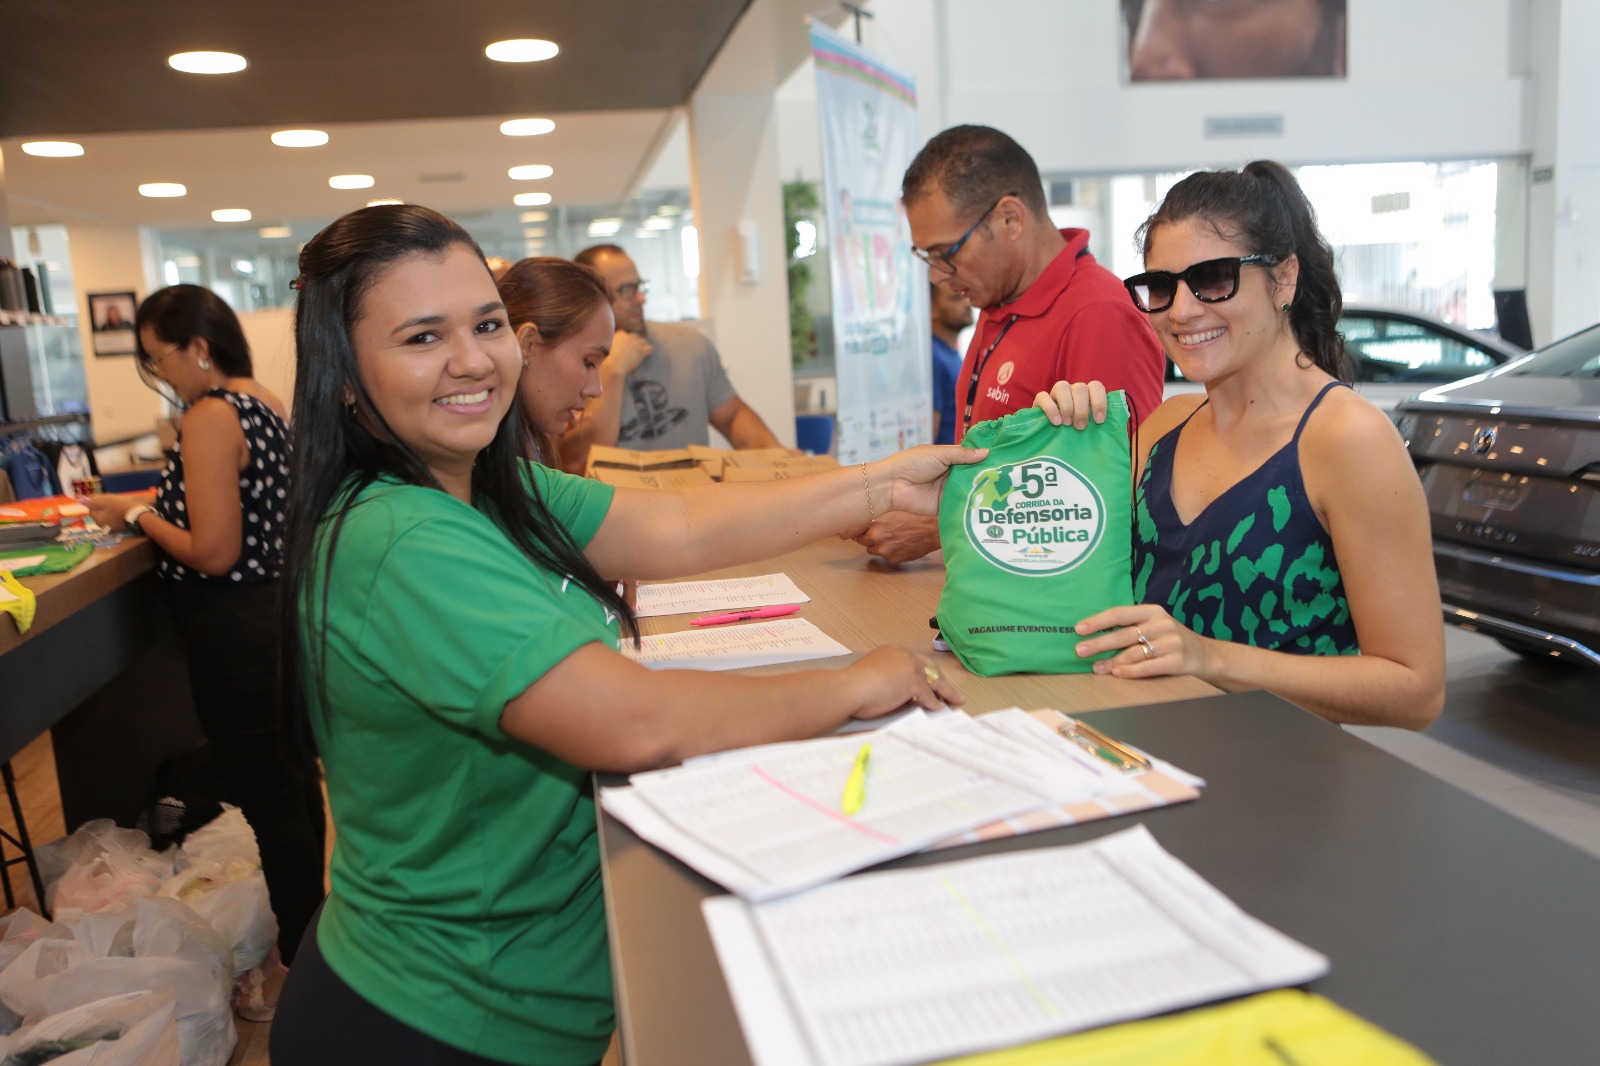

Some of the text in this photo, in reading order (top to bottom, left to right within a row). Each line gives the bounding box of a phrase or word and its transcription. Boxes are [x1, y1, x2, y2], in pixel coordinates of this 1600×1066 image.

[986, 386, 1010, 404] sabin
[1015, 499, 1051, 509] CORRIDA
[978, 504, 1092, 524] Defensoria
[1012, 526, 1089, 544] Pública
[968, 625, 1015, 635] VAGALUME
[1017, 625, 1058, 633] EVENTOS
